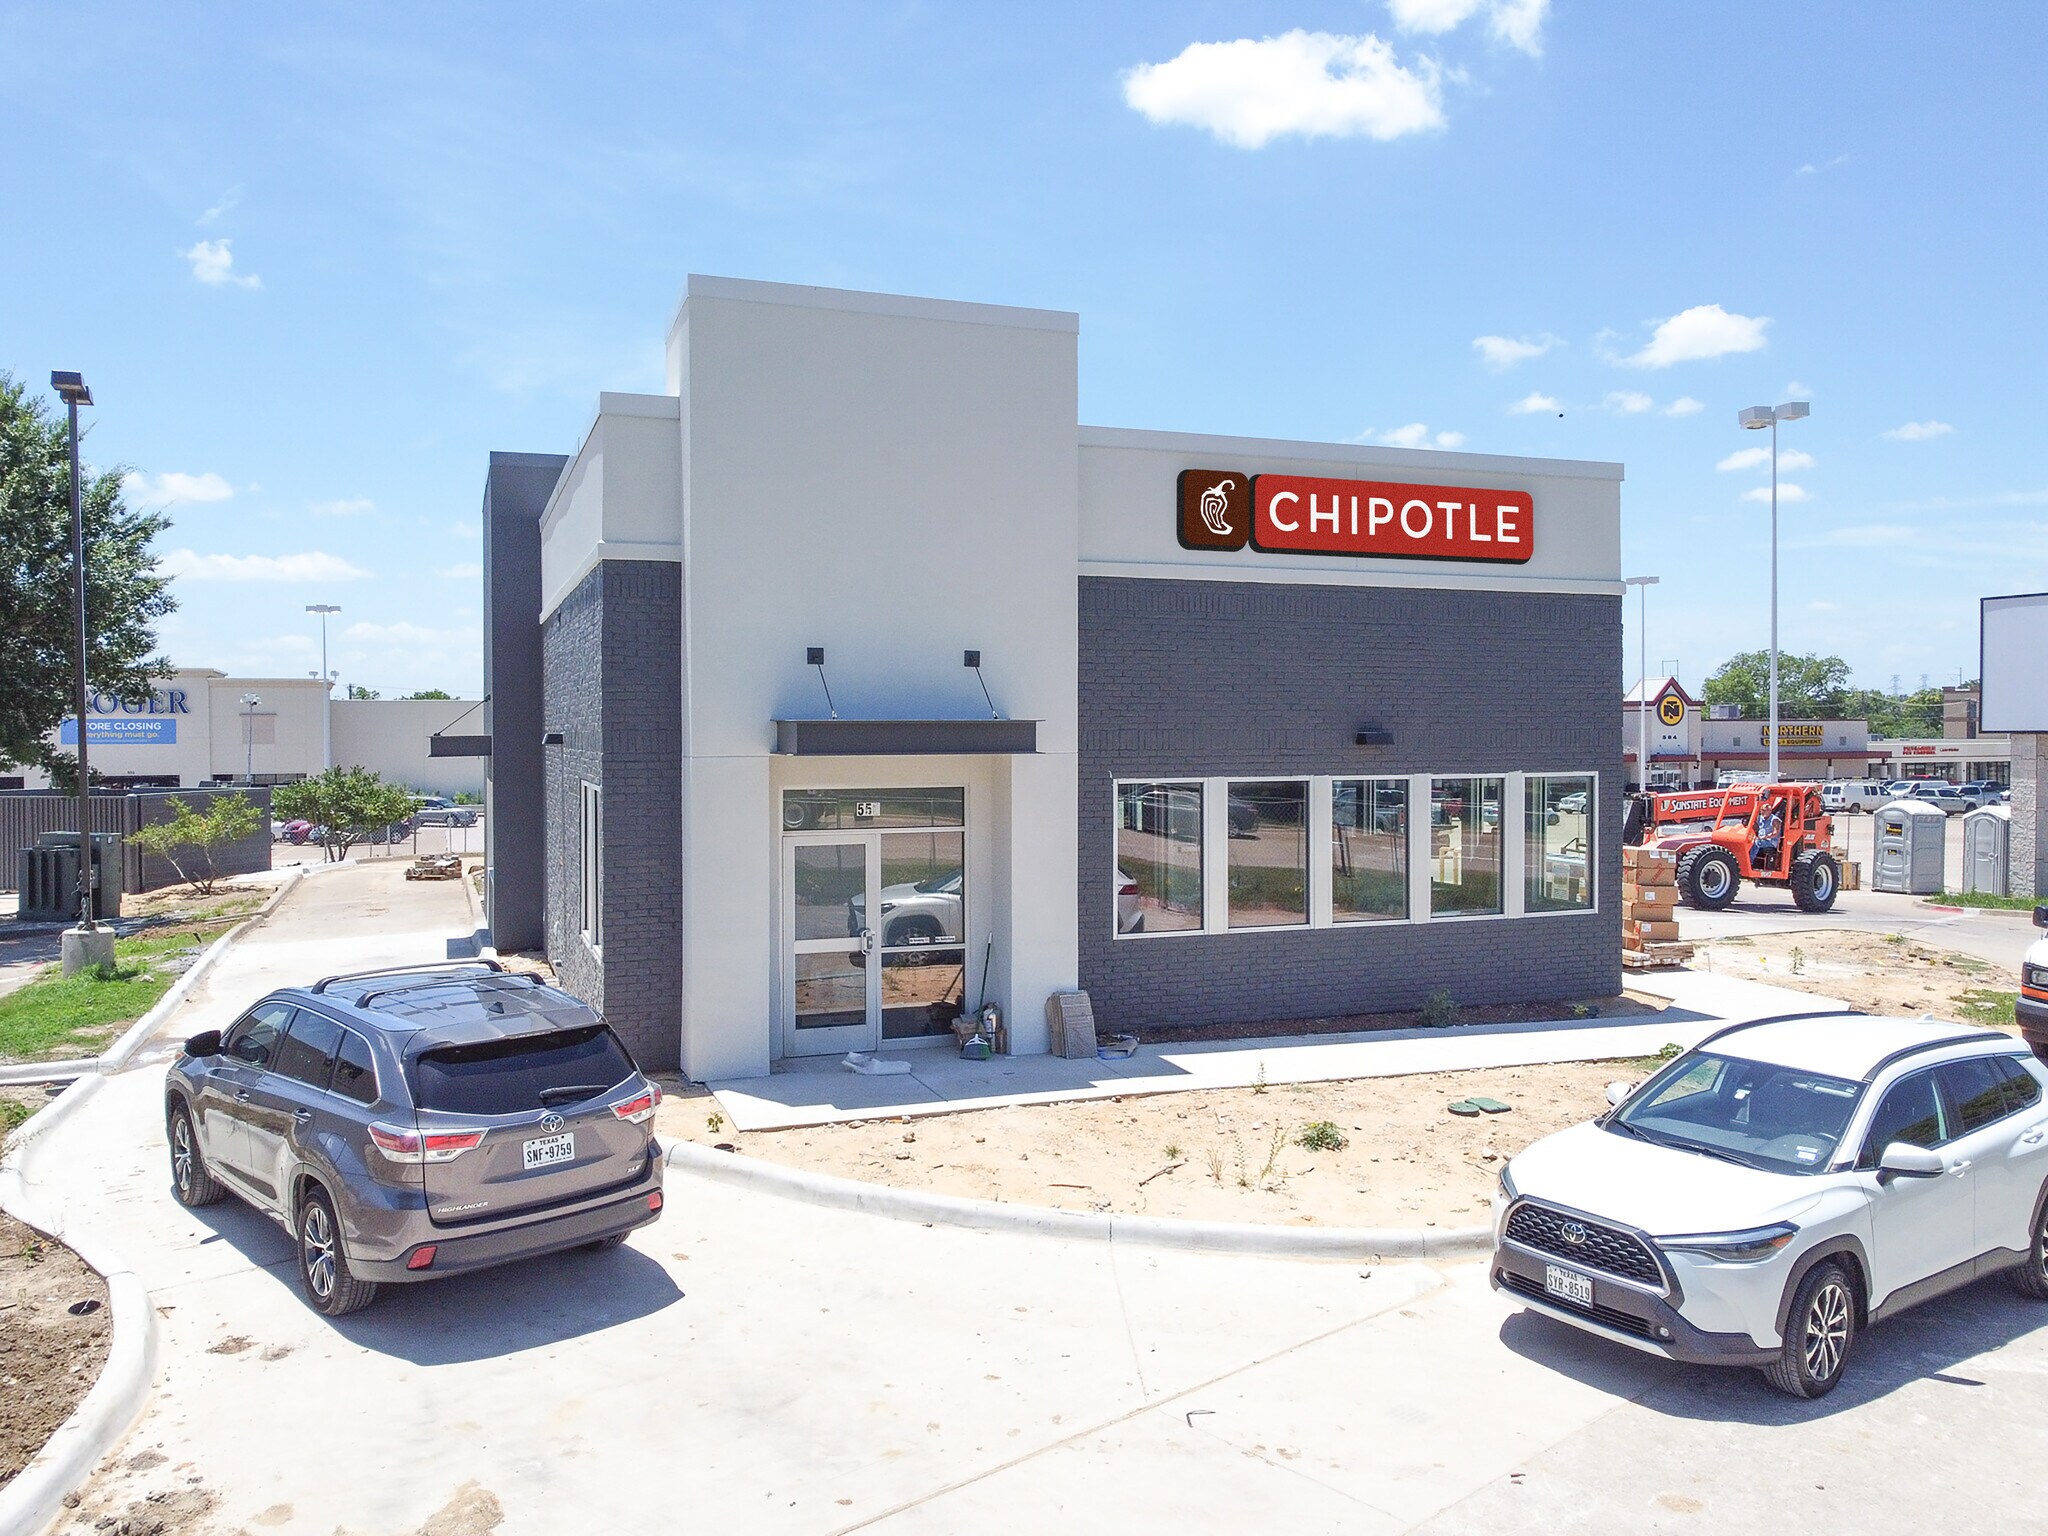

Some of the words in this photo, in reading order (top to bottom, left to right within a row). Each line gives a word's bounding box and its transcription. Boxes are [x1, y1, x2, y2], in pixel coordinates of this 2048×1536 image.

[1269, 491, 1520, 543] CHIPOTLE
[113, 722, 162, 731] CLOSING
[1763, 725, 1824, 736] NRTHERN
[147, 732, 160, 740] go.
[1670, 798, 1707, 813] SUNSTATE
[1709, 796, 1749, 808] EQUMENT
[539, 1137, 559, 1146] TEXAS
[626, 1164, 641, 1174] XLE
[437, 1201, 489, 1213] HIGHLANDER
[1559, 1268, 1578, 1281] TEXAS
